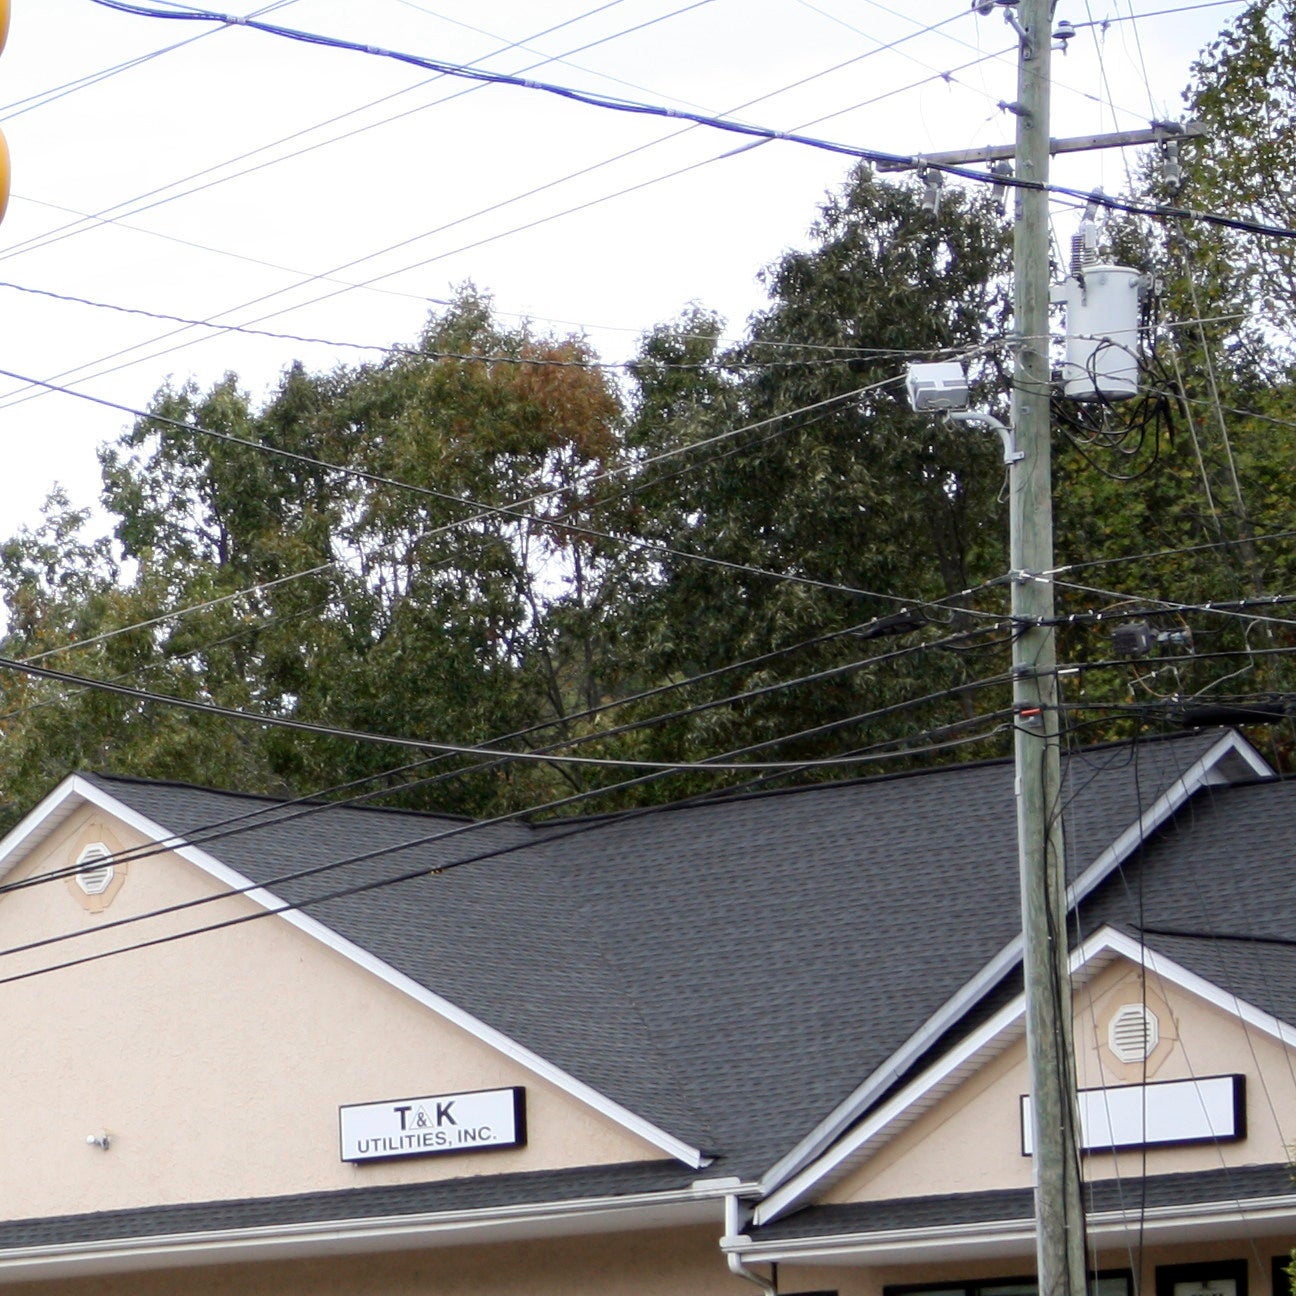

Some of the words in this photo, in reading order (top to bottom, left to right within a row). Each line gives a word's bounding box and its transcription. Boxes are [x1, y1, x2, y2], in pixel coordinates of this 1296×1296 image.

[393, 1100, 457, 1131] T&K
[357, 1131, 452, 1154] UTILITIES,
[458, 1126, 497, 1144] INC.
